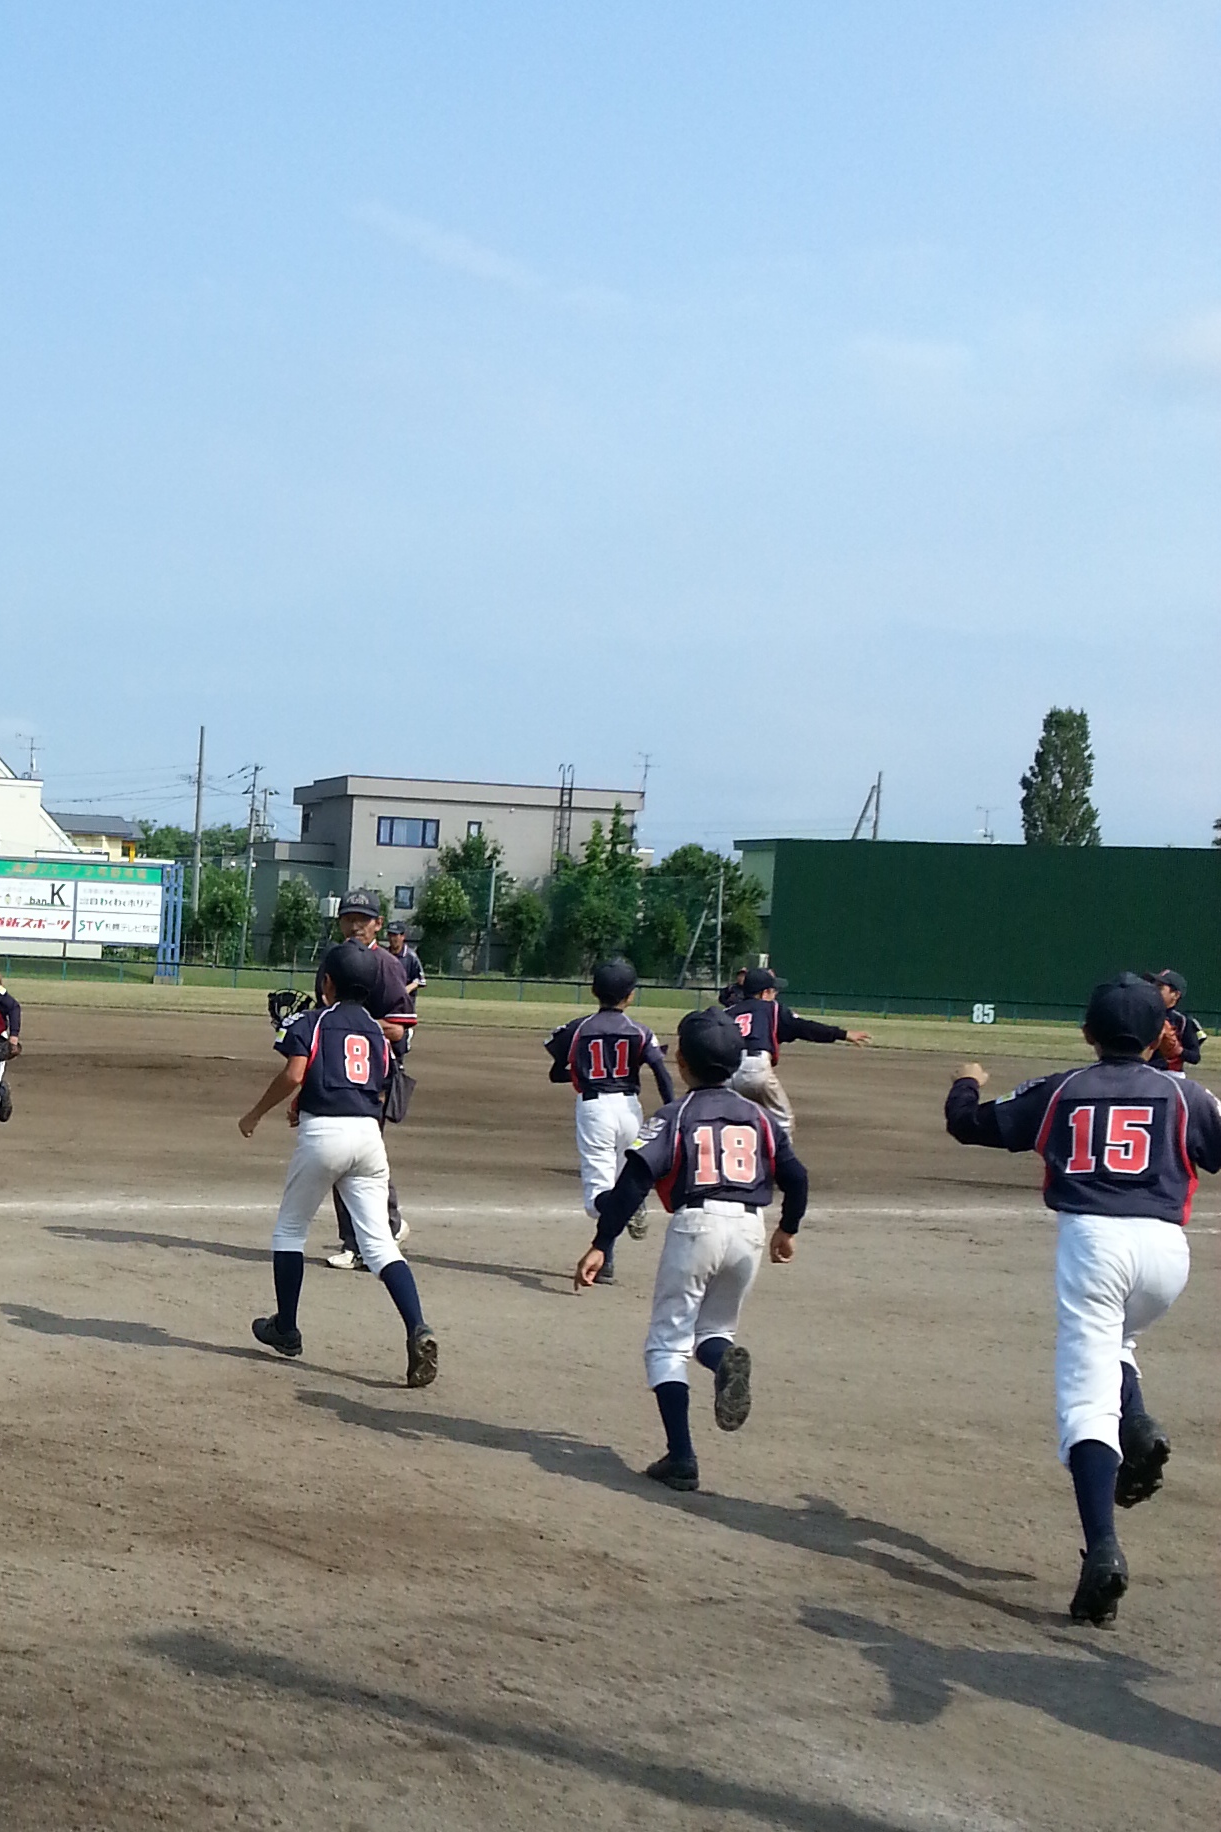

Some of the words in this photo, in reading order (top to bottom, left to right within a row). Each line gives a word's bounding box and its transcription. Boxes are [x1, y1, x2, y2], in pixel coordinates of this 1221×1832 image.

[78, 920, 105, 933] STV
[972, 1003, 995, 1024] 85
[344, 1034, 370, 1085] 8
[588, 1039, 630, 1080] 11
[693, 1125, 757, 1186] 18
[1065, 1105, 1154, 1175] 15
